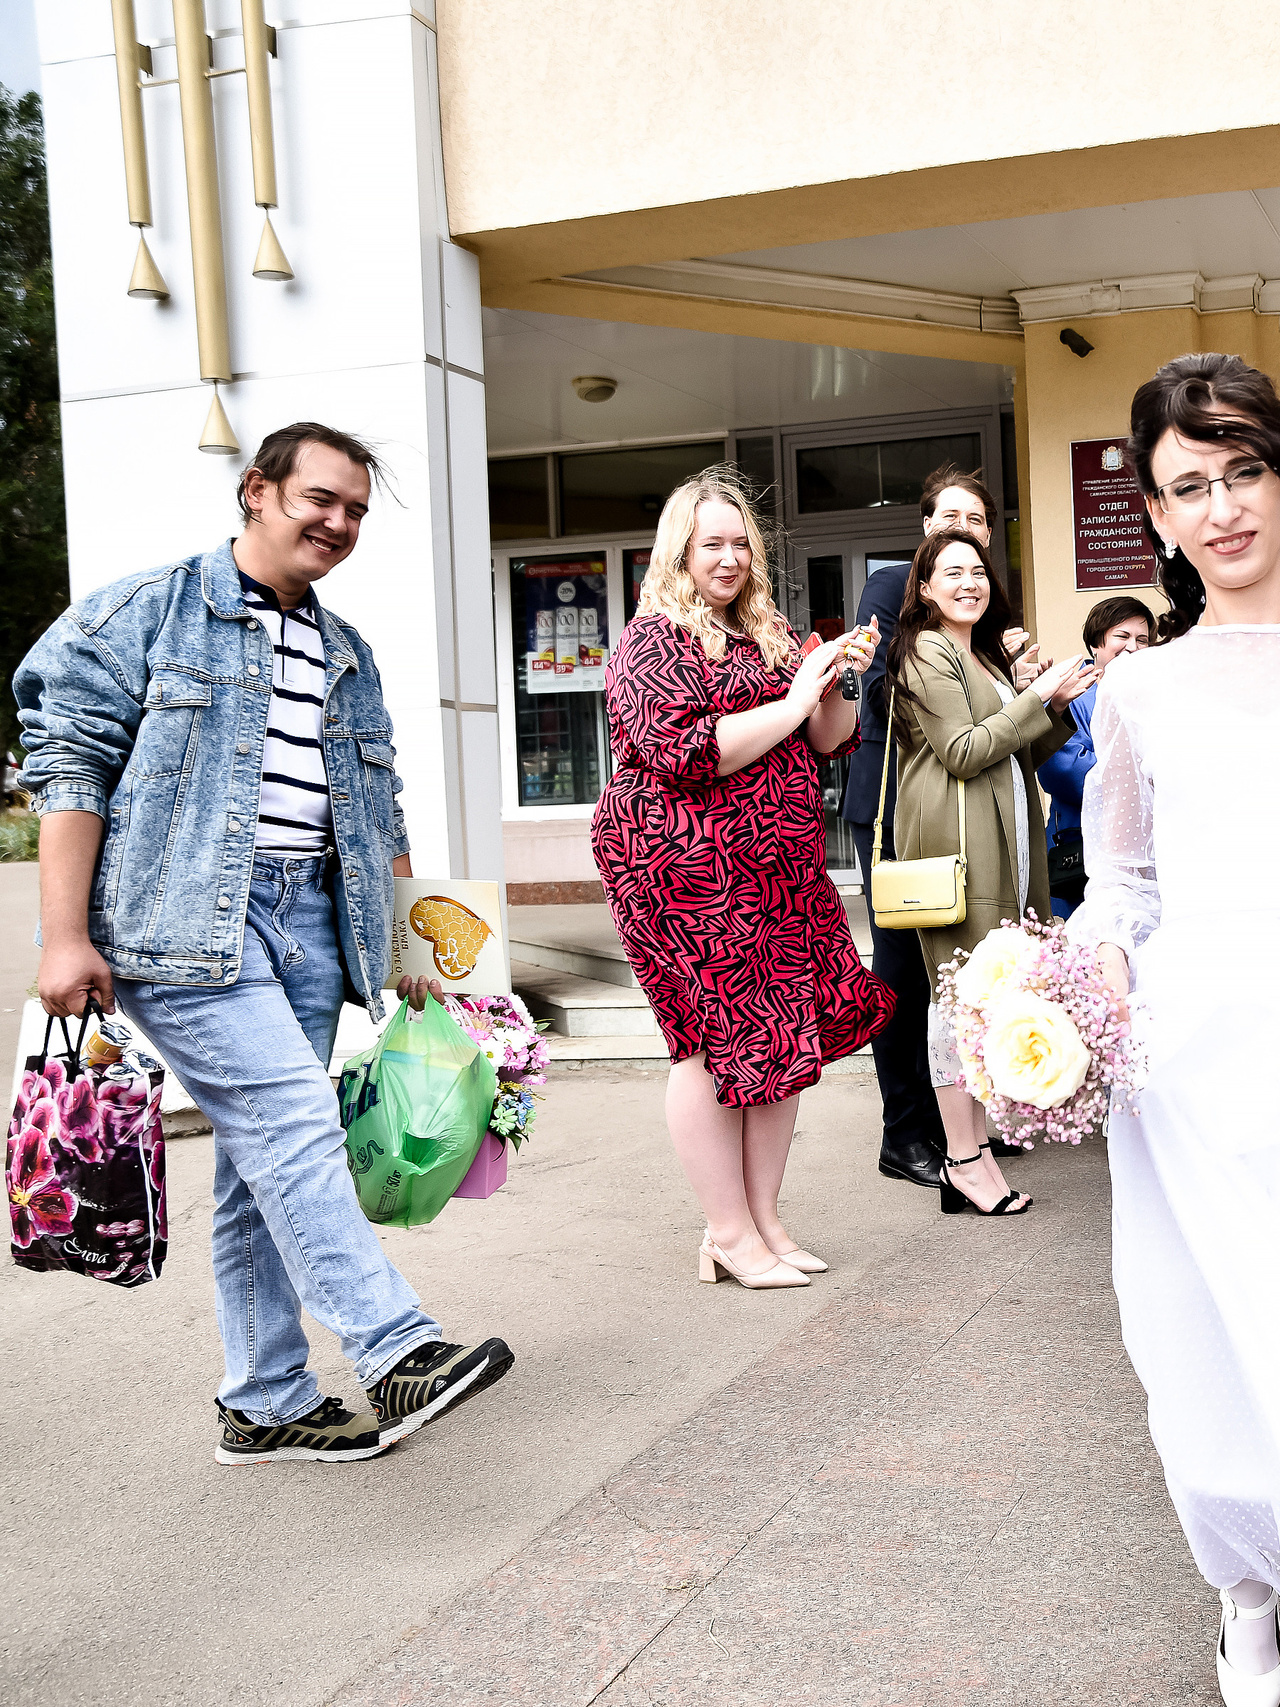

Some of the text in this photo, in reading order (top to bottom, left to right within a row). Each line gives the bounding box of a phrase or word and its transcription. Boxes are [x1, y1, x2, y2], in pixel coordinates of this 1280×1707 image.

[1099, 501, 1129, 512] ОТДЕЛ
[1080, 513, 1142, 525] ЗАПИСИ АКТО
[1079, 526, 1143, 538] ГРАЖДАНСКОГ
[1088, 539, 1143, 550] СОСТОЯНИЯ
[1077, 556, 1130, 564] ПРОМЫШЛЕННОГО
[1086, 565, 1124, 573] ГОРОДСКОГО
[398, 919, 409, 950] БРАКА
